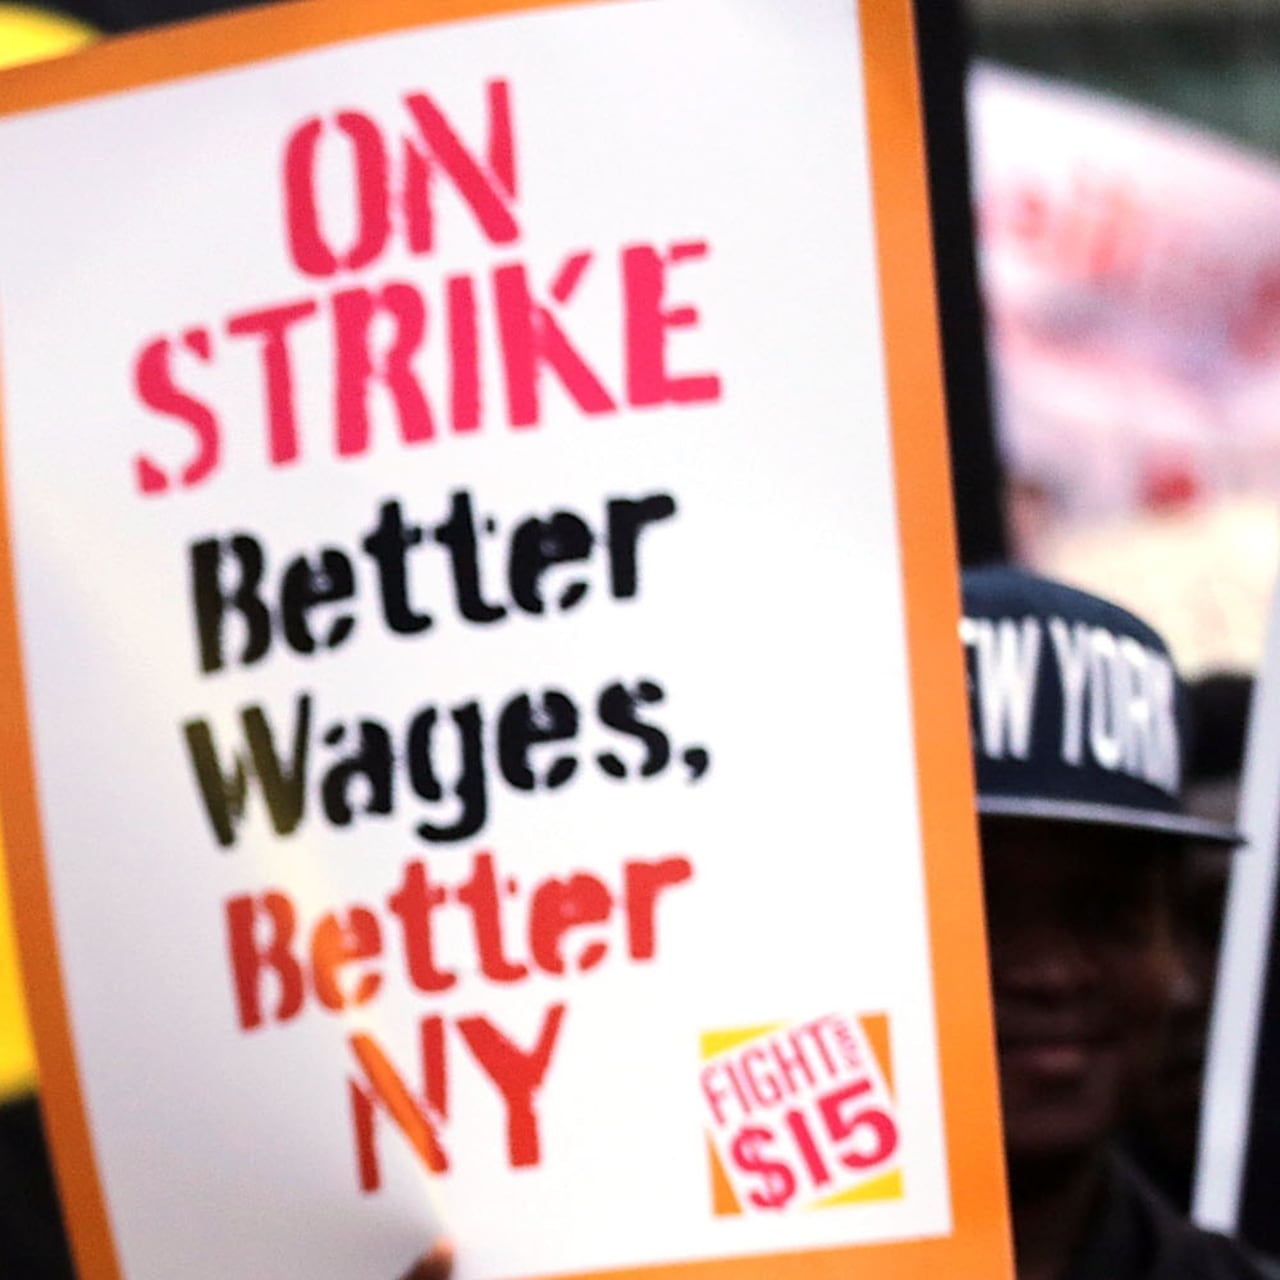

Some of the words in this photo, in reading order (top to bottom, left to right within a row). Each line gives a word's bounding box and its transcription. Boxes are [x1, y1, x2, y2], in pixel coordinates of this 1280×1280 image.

[280, 76, 522, 280] ON
[131, 238, 725, 498] STRIKE
[187, 488, 680, 675] Better
[181, 676, 712, 848] Wages,
[223, 848, 696, 1034] Better
[344, 1000, 570, 1195] NY
[699, 1012, 840, 1129] FIGHT
[728, 1076, 900, 1214] $15
